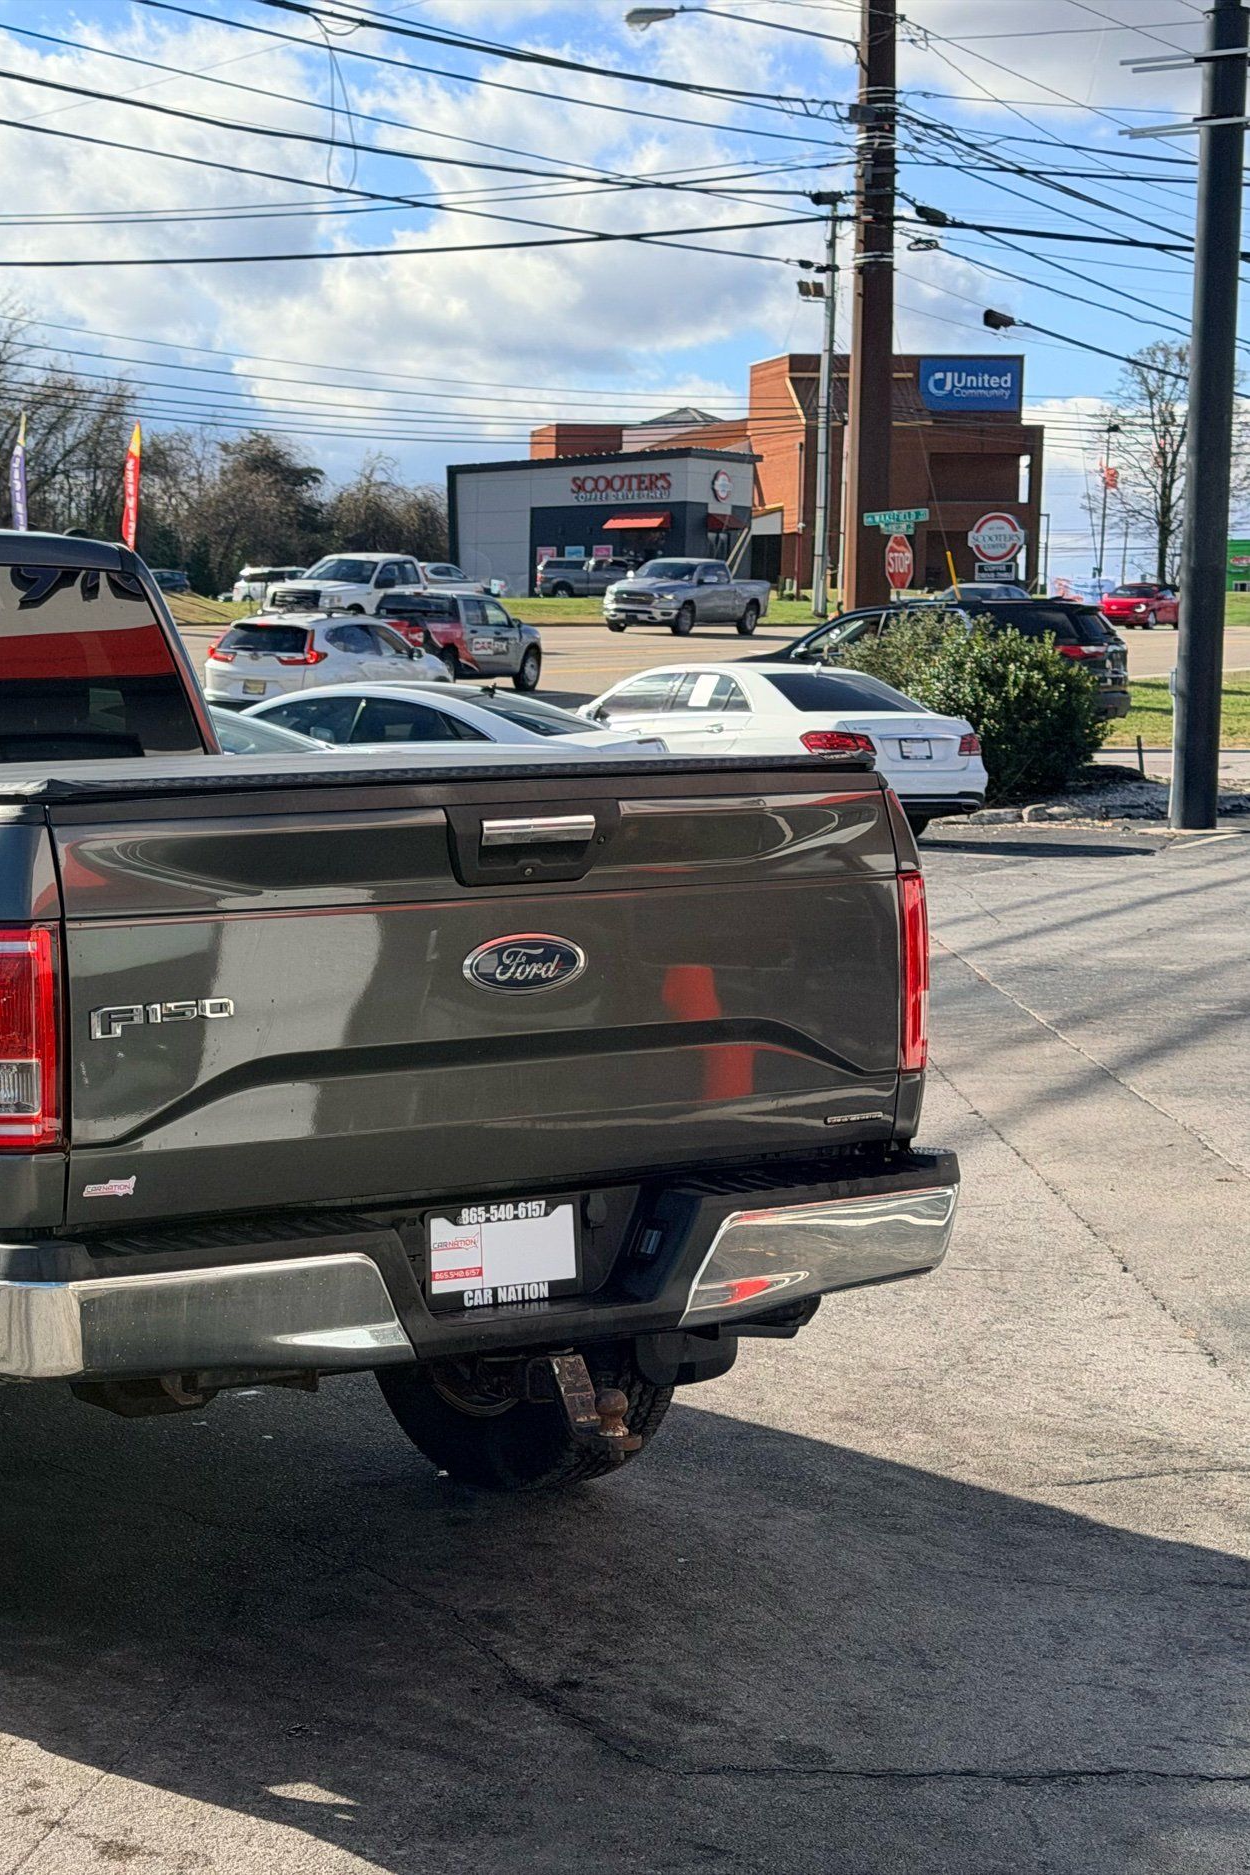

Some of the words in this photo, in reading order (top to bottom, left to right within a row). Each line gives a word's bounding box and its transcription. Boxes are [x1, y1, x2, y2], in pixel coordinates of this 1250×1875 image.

[953, 372, 1012, 388] United
[953, 387, 1011, 400] Community
[573, 491, 608, 502] COFFEE
[888, 552, 910, 573] STOP
[495, 947, 561, 982] Ford
[461, 1200, 546, 1225] 865-540-6157
[463, 1288, 493, 1308] CAR
[497, 1281, 550, 1303] NATION
